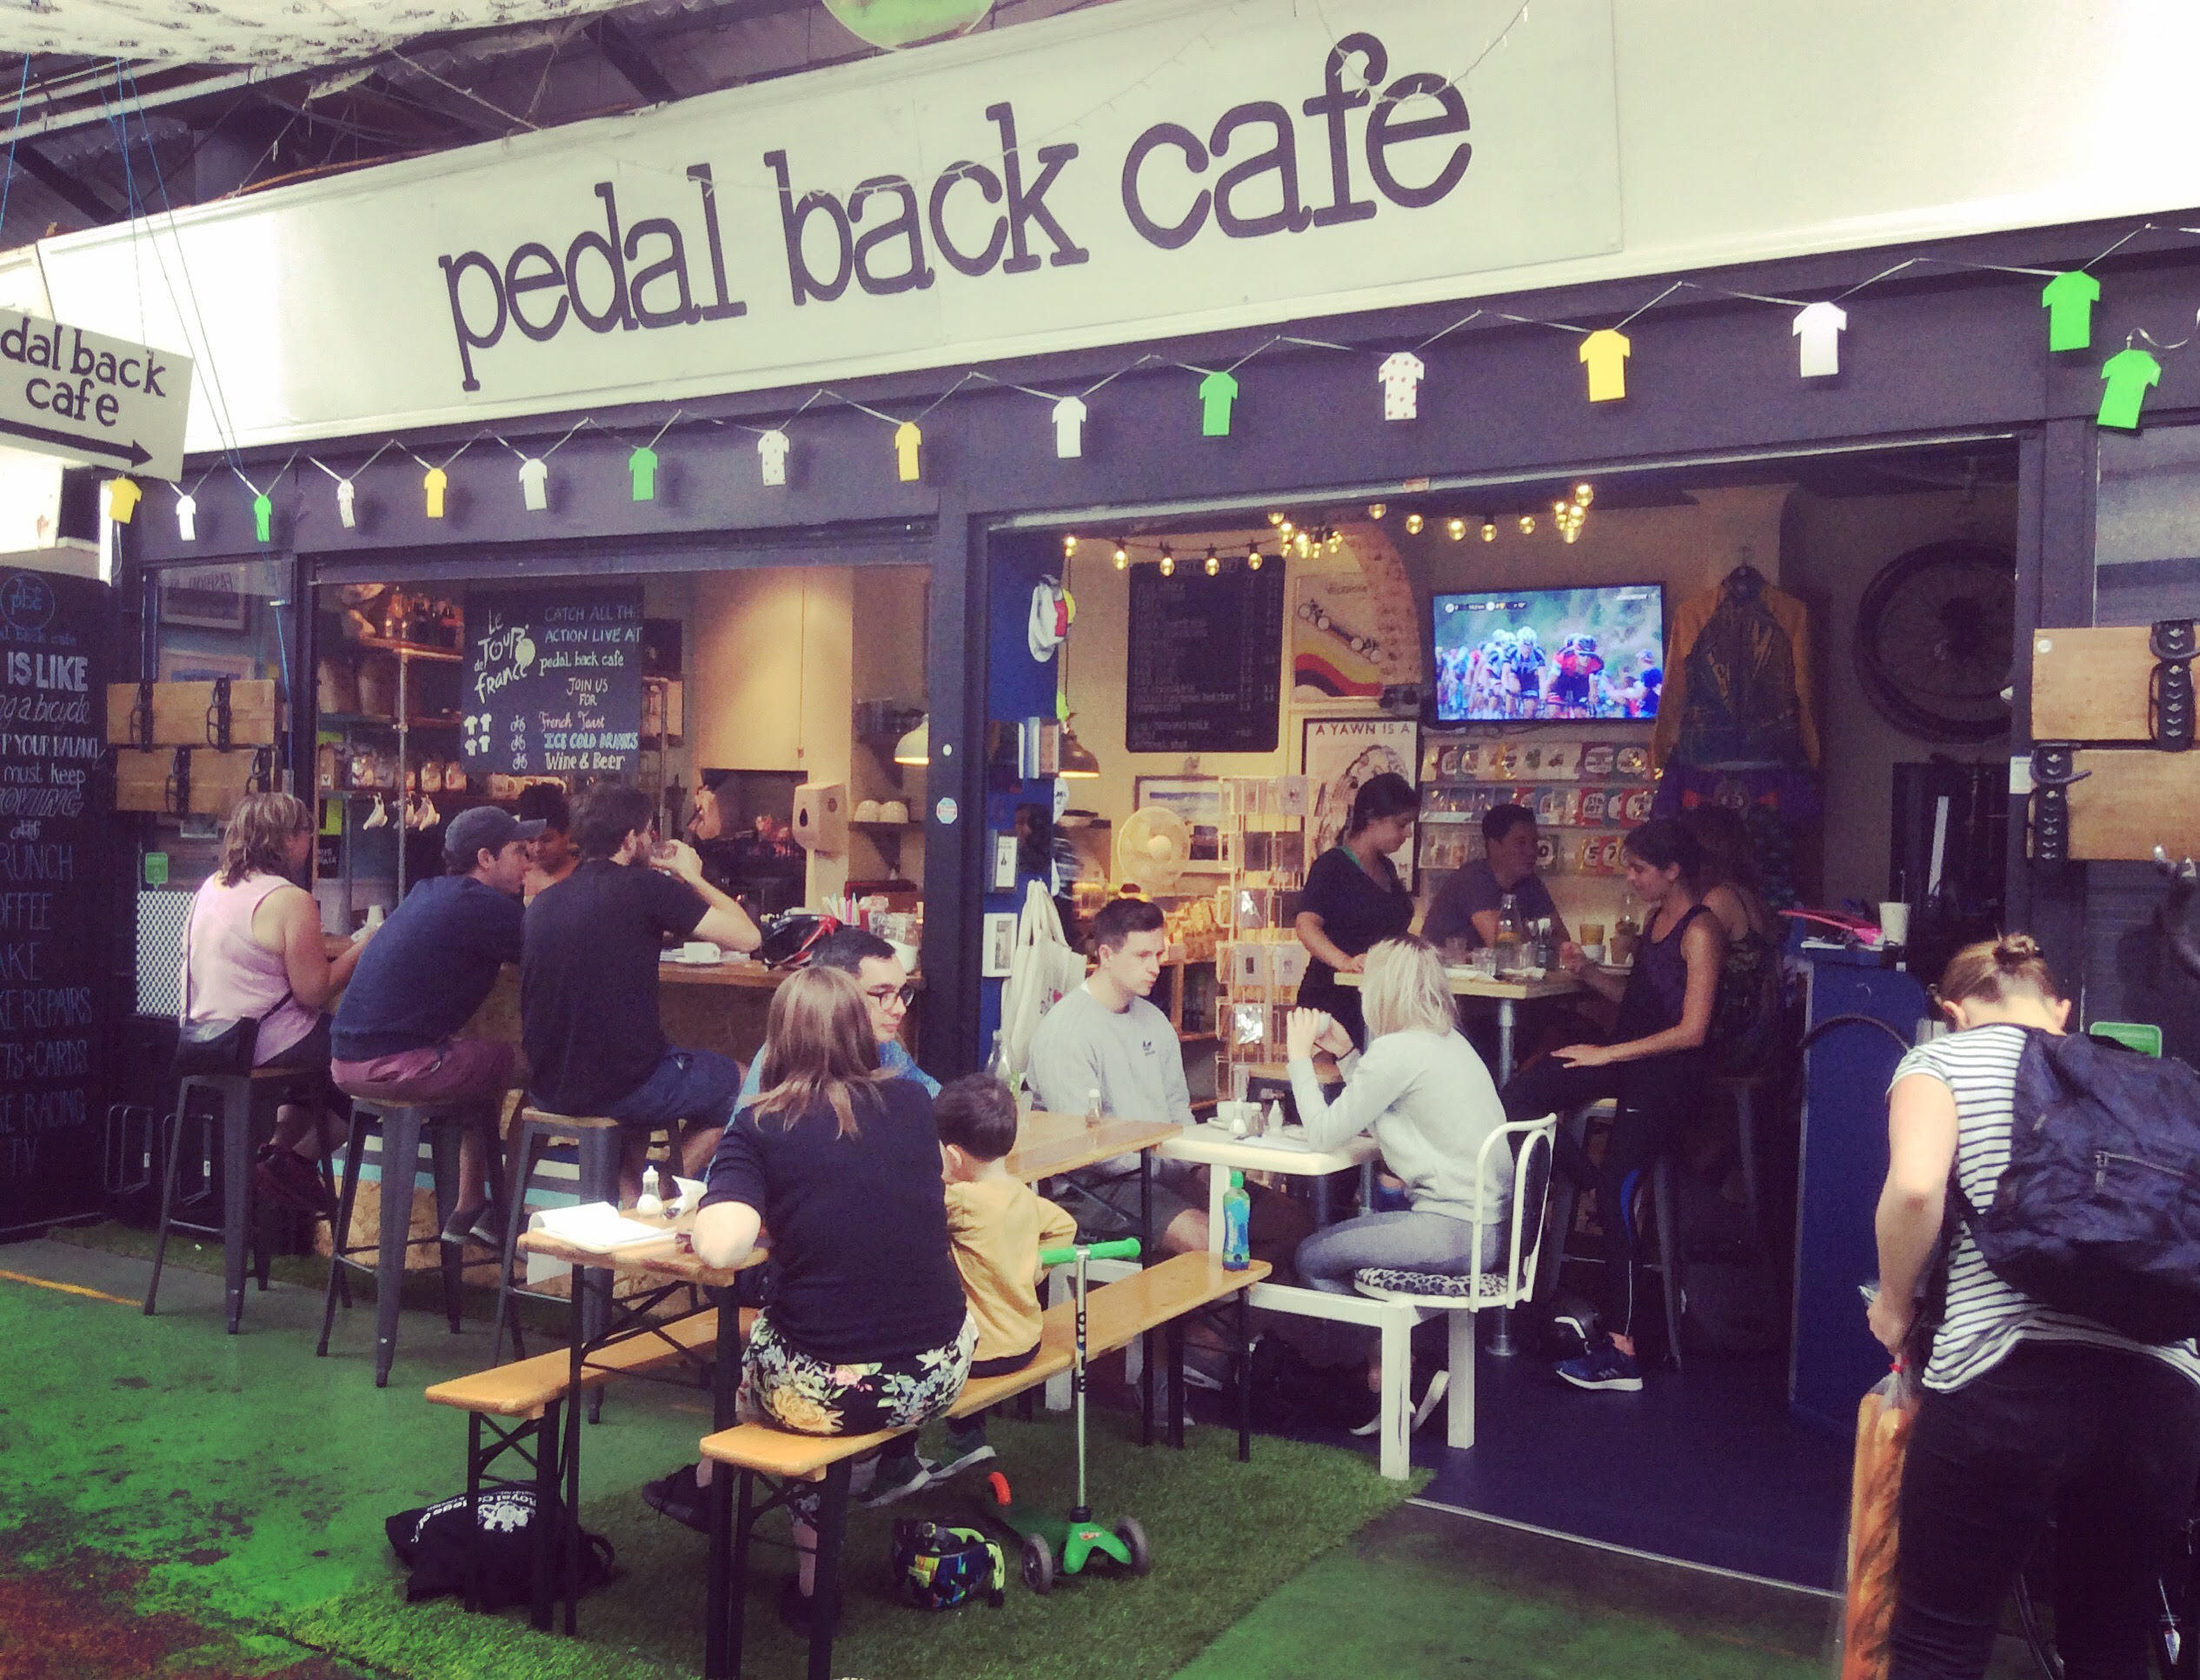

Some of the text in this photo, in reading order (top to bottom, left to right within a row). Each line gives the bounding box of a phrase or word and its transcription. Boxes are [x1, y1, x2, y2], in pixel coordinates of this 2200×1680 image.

[438, 32, 1472, 391] pedal back cafe
[0, 316, 167, 397] dal back
[25, 377, 119, 427] cafe
[544, 606, 584, 622] CATCH
[588, 606, 613, 621] ALL
[545, 626, 643, 643] ACTION LIVE AT
[8, 651, 89, 692] IS LIKE
[539, 650, 624, 676] pedal back cafe
[567, 677, 608, 695] JOIN US
[33, 694, 90, 730] bicycle
[579, 694, 597, 707] FOR
[539, 710, 605, 733] French Toast
[1315, 723, 1411, 735] A YAWN IS A
[15, 734, 50, 757] YOUR
[544, 734, 567, 749] ICE
[569, 733, 596, 750] COLD
[545, 752, 626, 771] Wine & Beer
[4, 761, 86, 793] must keep
[23, 986, 92, 1028] REPAIRS
